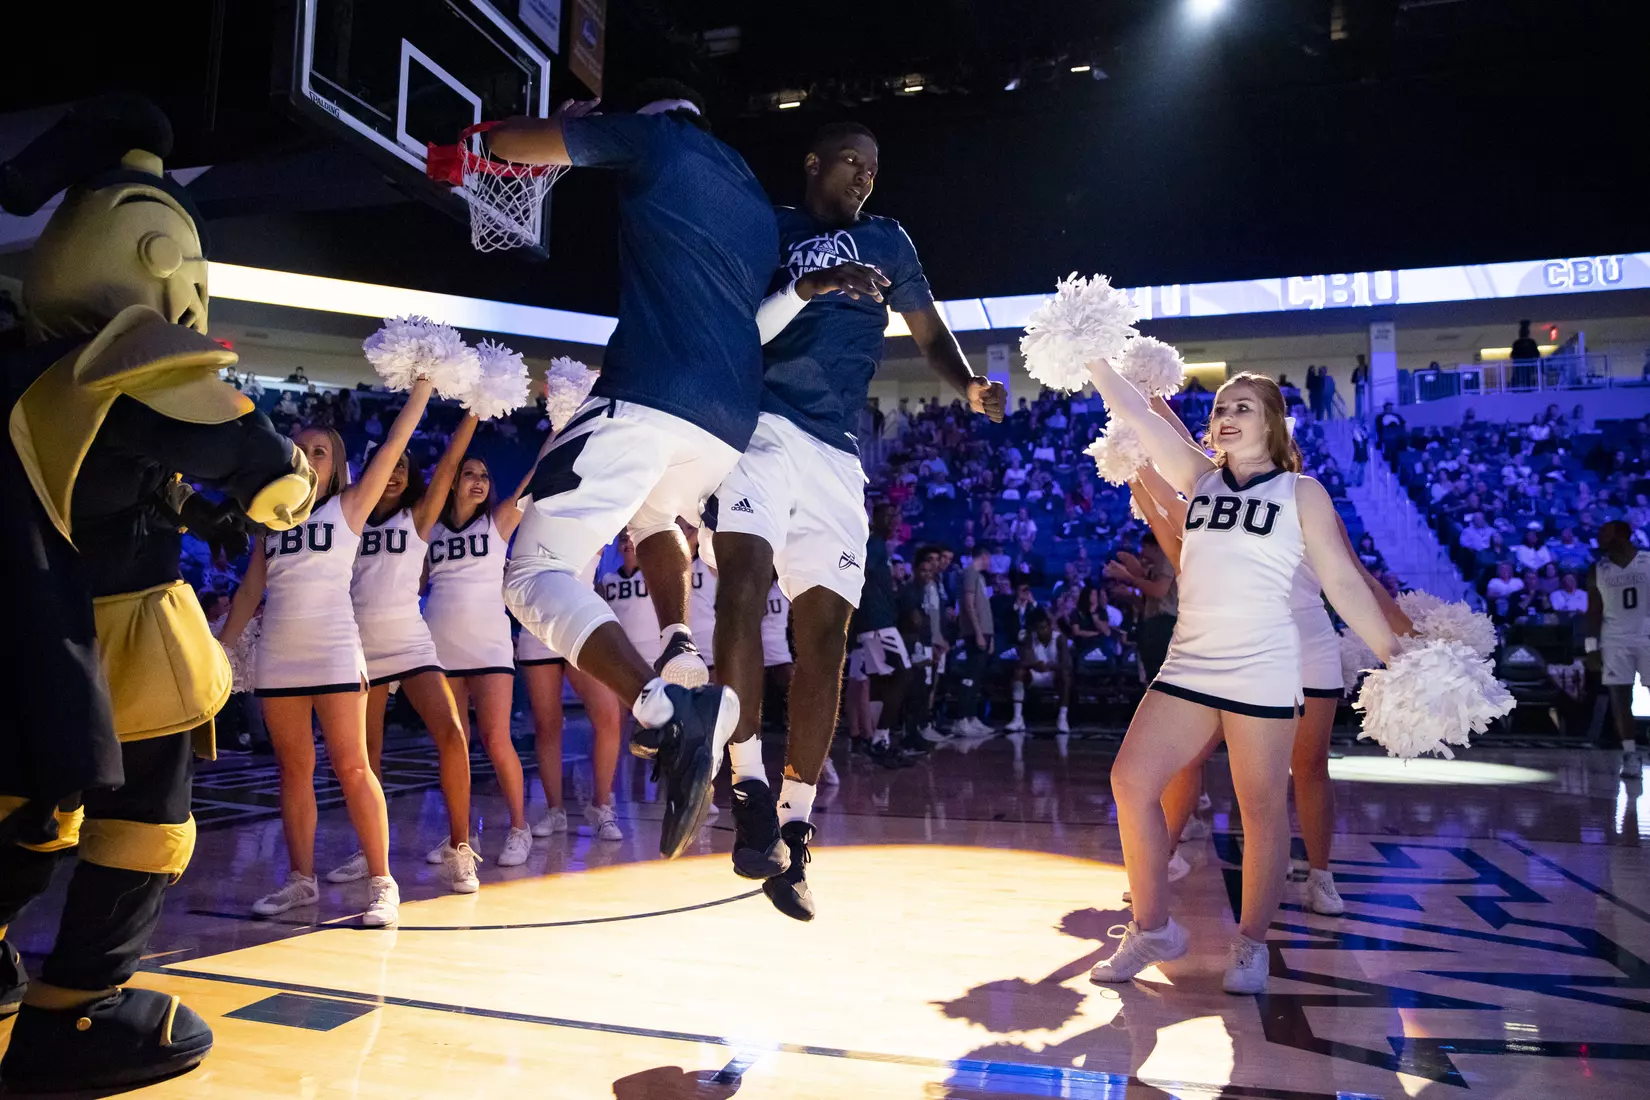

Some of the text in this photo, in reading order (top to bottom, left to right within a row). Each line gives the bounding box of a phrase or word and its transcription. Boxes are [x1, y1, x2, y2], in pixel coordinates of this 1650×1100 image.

[309, 90, 340, 119] SPALDING
[1543, 257, 1624, 288] CBU
[1279, 269, 1400, 310] CBU
[730, 506, 754, 514] adidas
[1185, 494, 1282, 537] CBU
[360, 528, 408, 556] BU
[429, 533, 489, 564] CBU
[606, 580, 648, 601] CBU
[1622, 587, 1638, 609] 0
